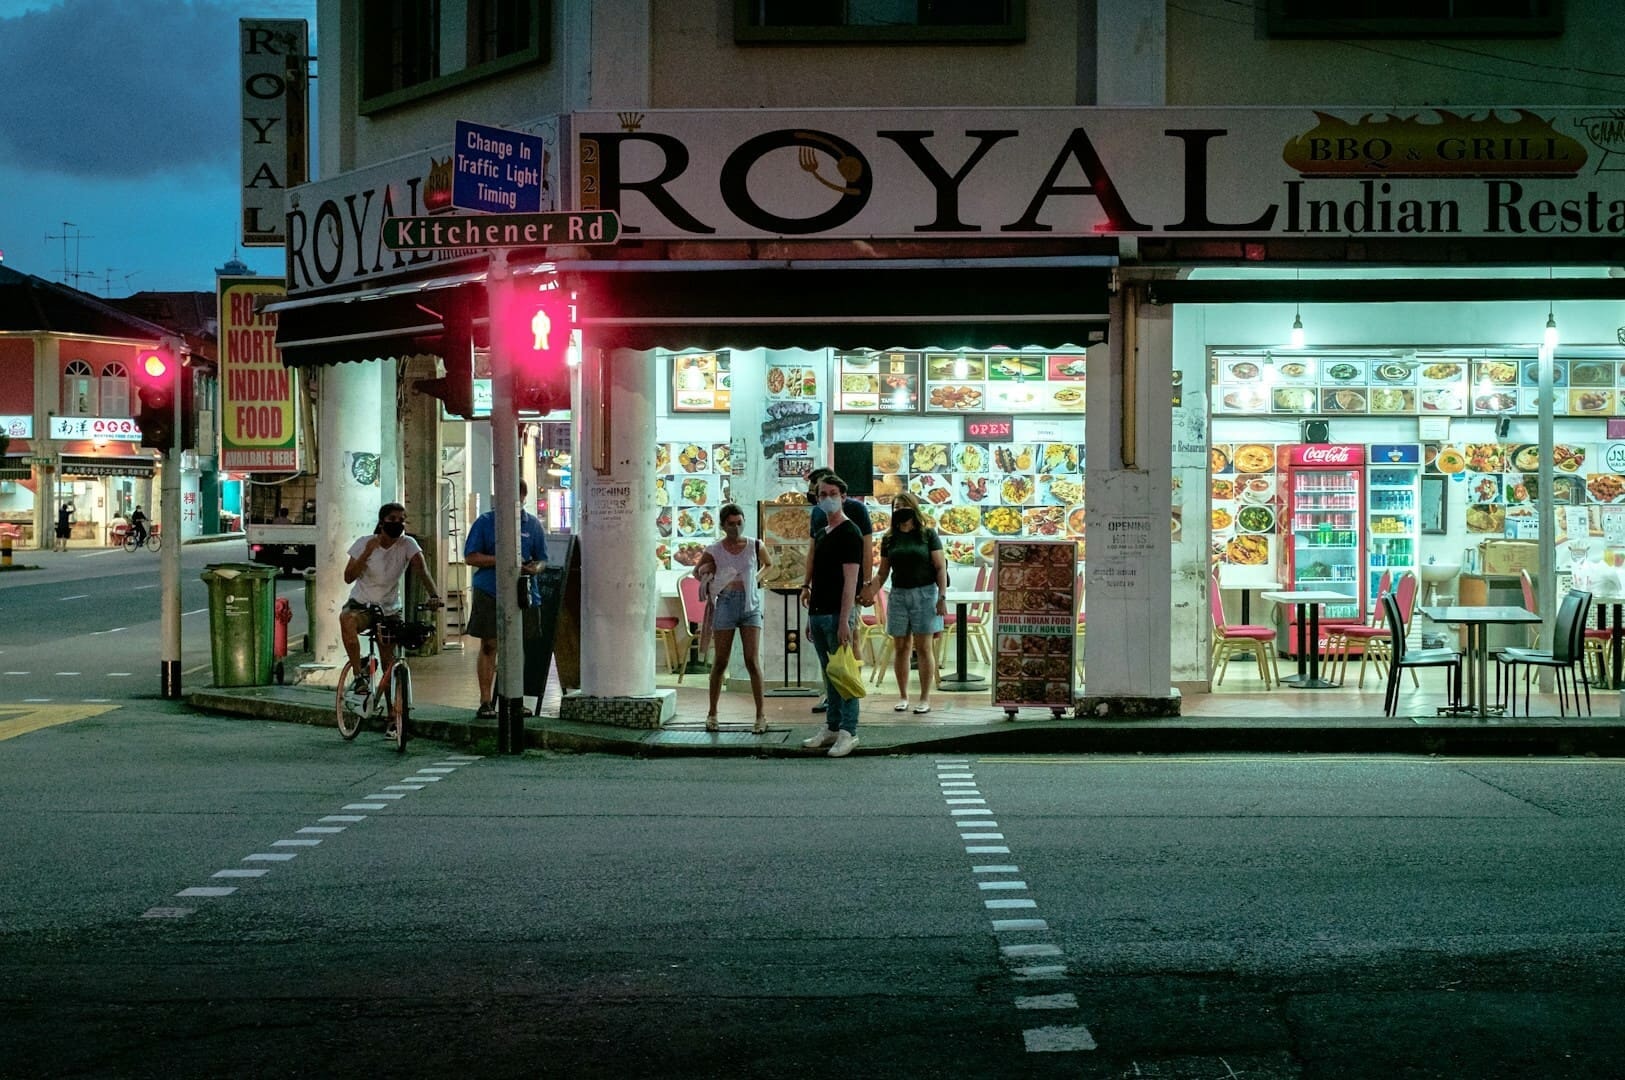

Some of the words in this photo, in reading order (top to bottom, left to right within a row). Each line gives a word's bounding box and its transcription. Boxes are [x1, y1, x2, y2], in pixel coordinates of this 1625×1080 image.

[244, 28, 285, 233] ROYAL
[467, 131, 513, 157] Change
[519, 145, 531, 160] In
[1309, 138, 1393, 169] BBQ
[1406, 148, 1422, 161] &
[1436, 138, 1570, 161] GRILL
[457, 154, 499, 179] Traffic
[506, 163, 538, 188] Light
[579, 128, 1279, 234] ROYAL
[583, 146, 596, 211] 22
[477, 183, 517, 209] Timing
[1282, 180, 1462, 234] Indian
[398, 217, 553, 246] Kitchener
[568, 215, 604, 241] Rd
[227, 329, 283, 364] NORT
[228, 368, 290, 401] INDIAN
[236, 406, 283, 440] FOOD
[969, 423, 1010, 436] OPEN
[272, 450, 295, 467] HERE
[591, 487, 631, 497] OPENING
[1108, 521, 1152, 531] OPENING
[998, 615, 1021, 624] ROYAL
[1023, 616, 1049, 624] INDIAN
[1051, 616, 1071, 625] FOOD
[998, 624, 1017, 633] PURE
[1019, 625, 1033, 633] VEG
[1040, 625, 1056, 633] NON
[1057, 625, 1071, 633] VEG
